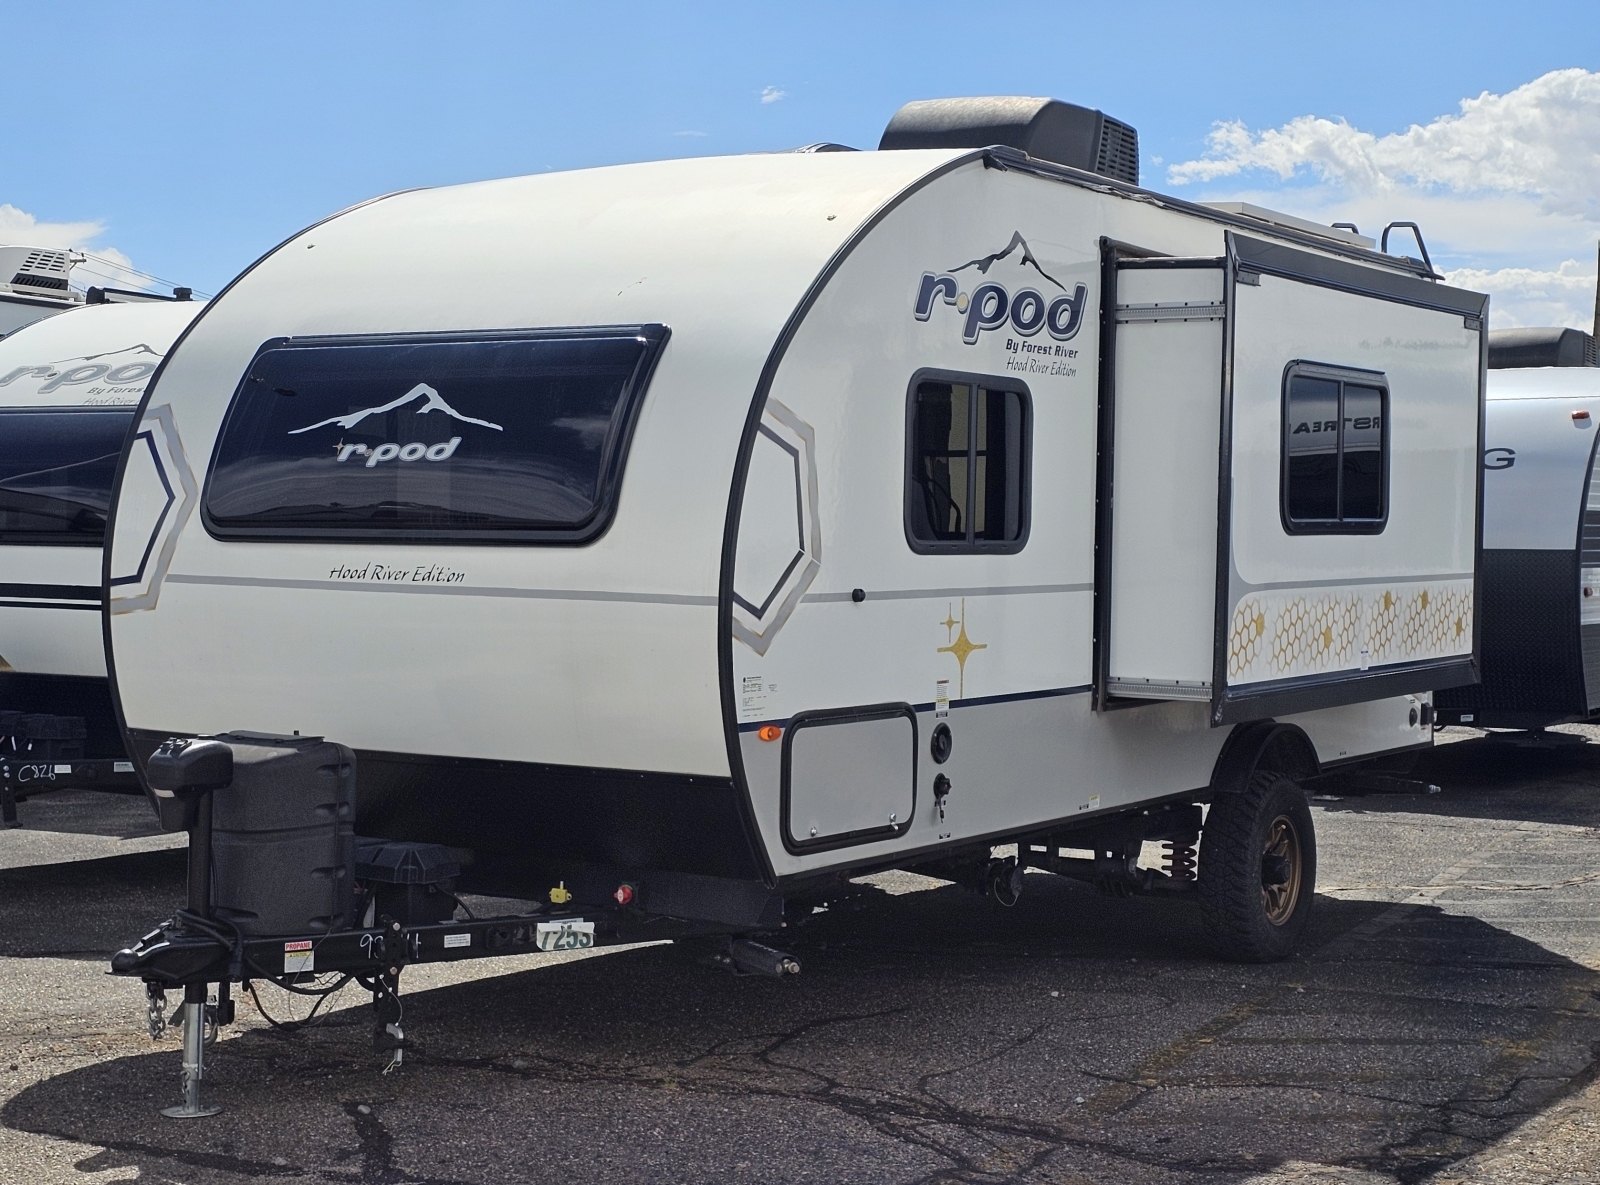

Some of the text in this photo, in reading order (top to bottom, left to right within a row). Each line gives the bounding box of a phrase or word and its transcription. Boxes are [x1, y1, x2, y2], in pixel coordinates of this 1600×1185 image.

[1006, 338, 1079, 359] By Forest River
[1006, 356, 1077, 377] Hood River Edition
[87, 386, 144, 395] By Fores
[1484, 448, 1516, 470] G
[329, 562, 465, 583] Hood River Edition
[18, 764, 55, 782] C826
[285, 941, 311, 950] PROPANE
